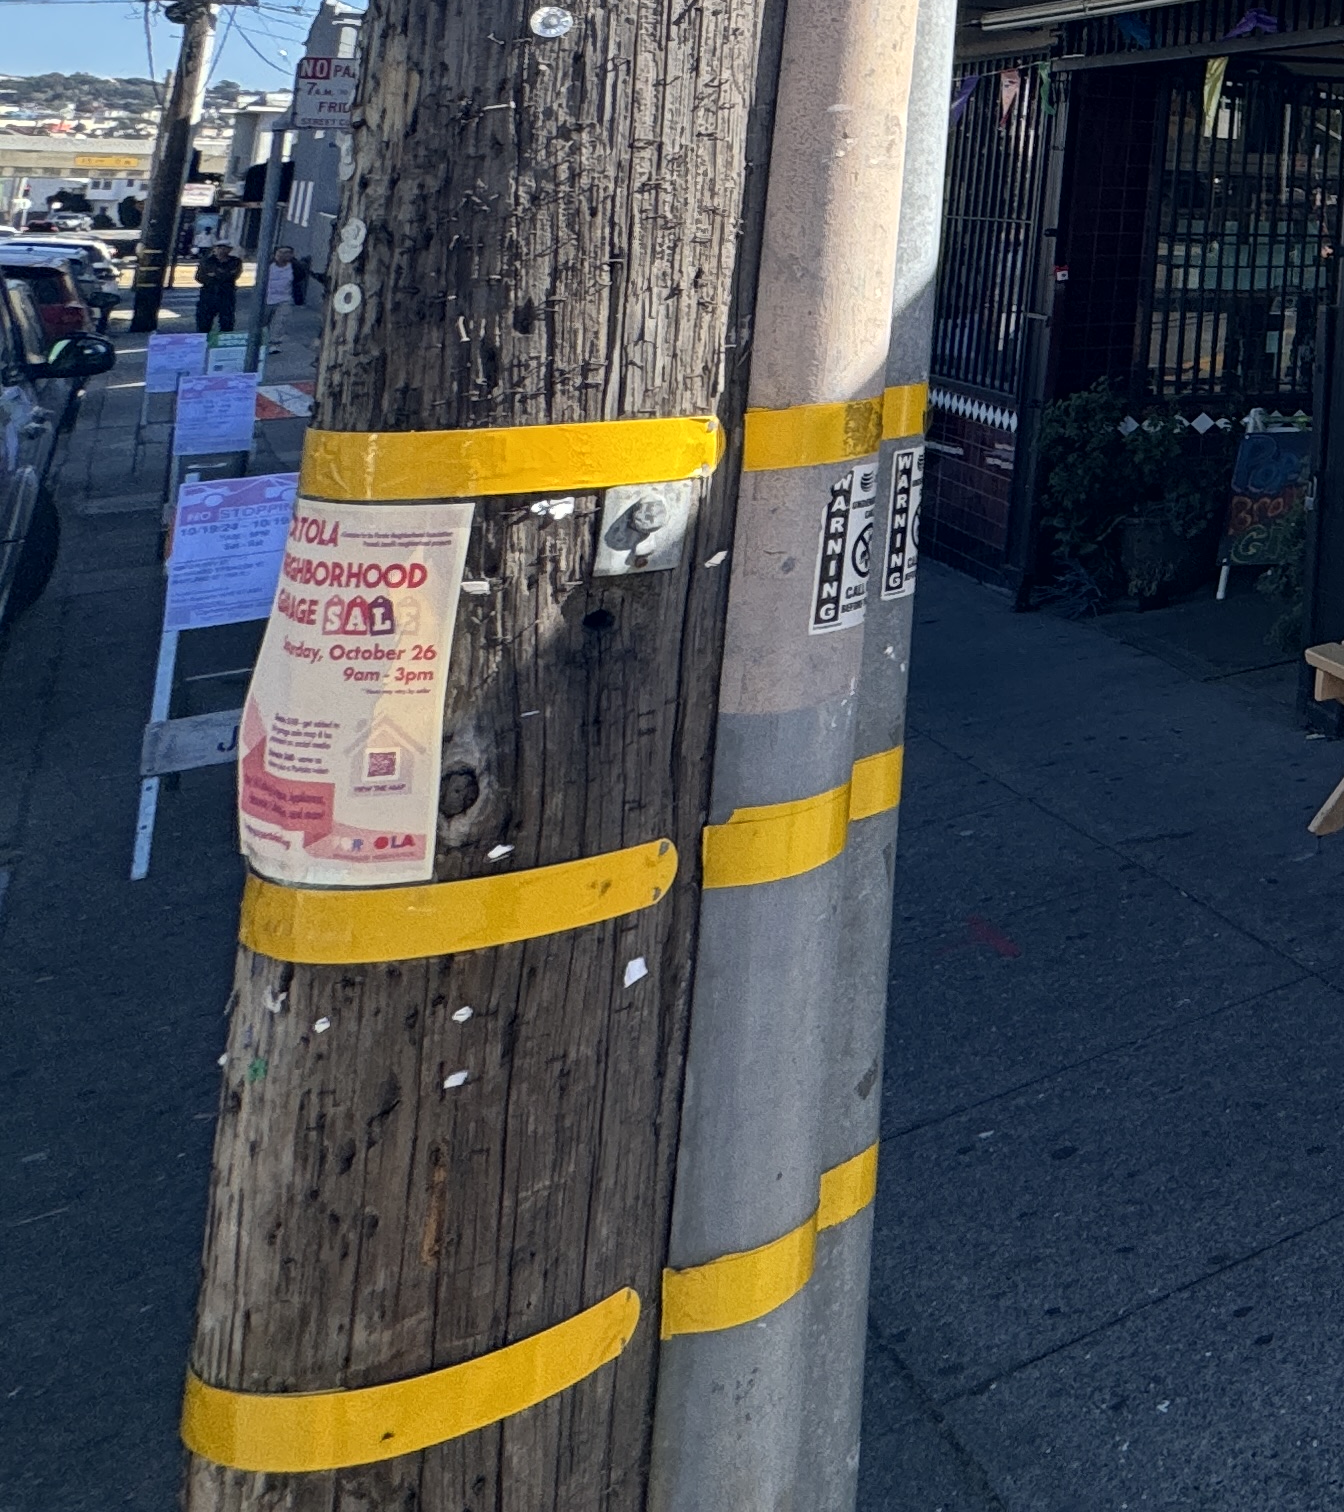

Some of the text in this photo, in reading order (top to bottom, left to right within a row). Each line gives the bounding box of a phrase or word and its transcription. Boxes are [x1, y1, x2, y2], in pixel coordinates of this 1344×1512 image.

[301, 59, 356, 79] NO PA
[220, 502, 290, 520] STOPPIN
[290, 516, 340, 547] TOLA
[889, 455, 913, 588] WARNING
[819, 472, 852, 621] WARNING
[329, 642, 407, 661] October
[411, 644, 438, 661] 26
[343, 666, 381, 682] 9am
[393, 666, 434, 685] 3pm
